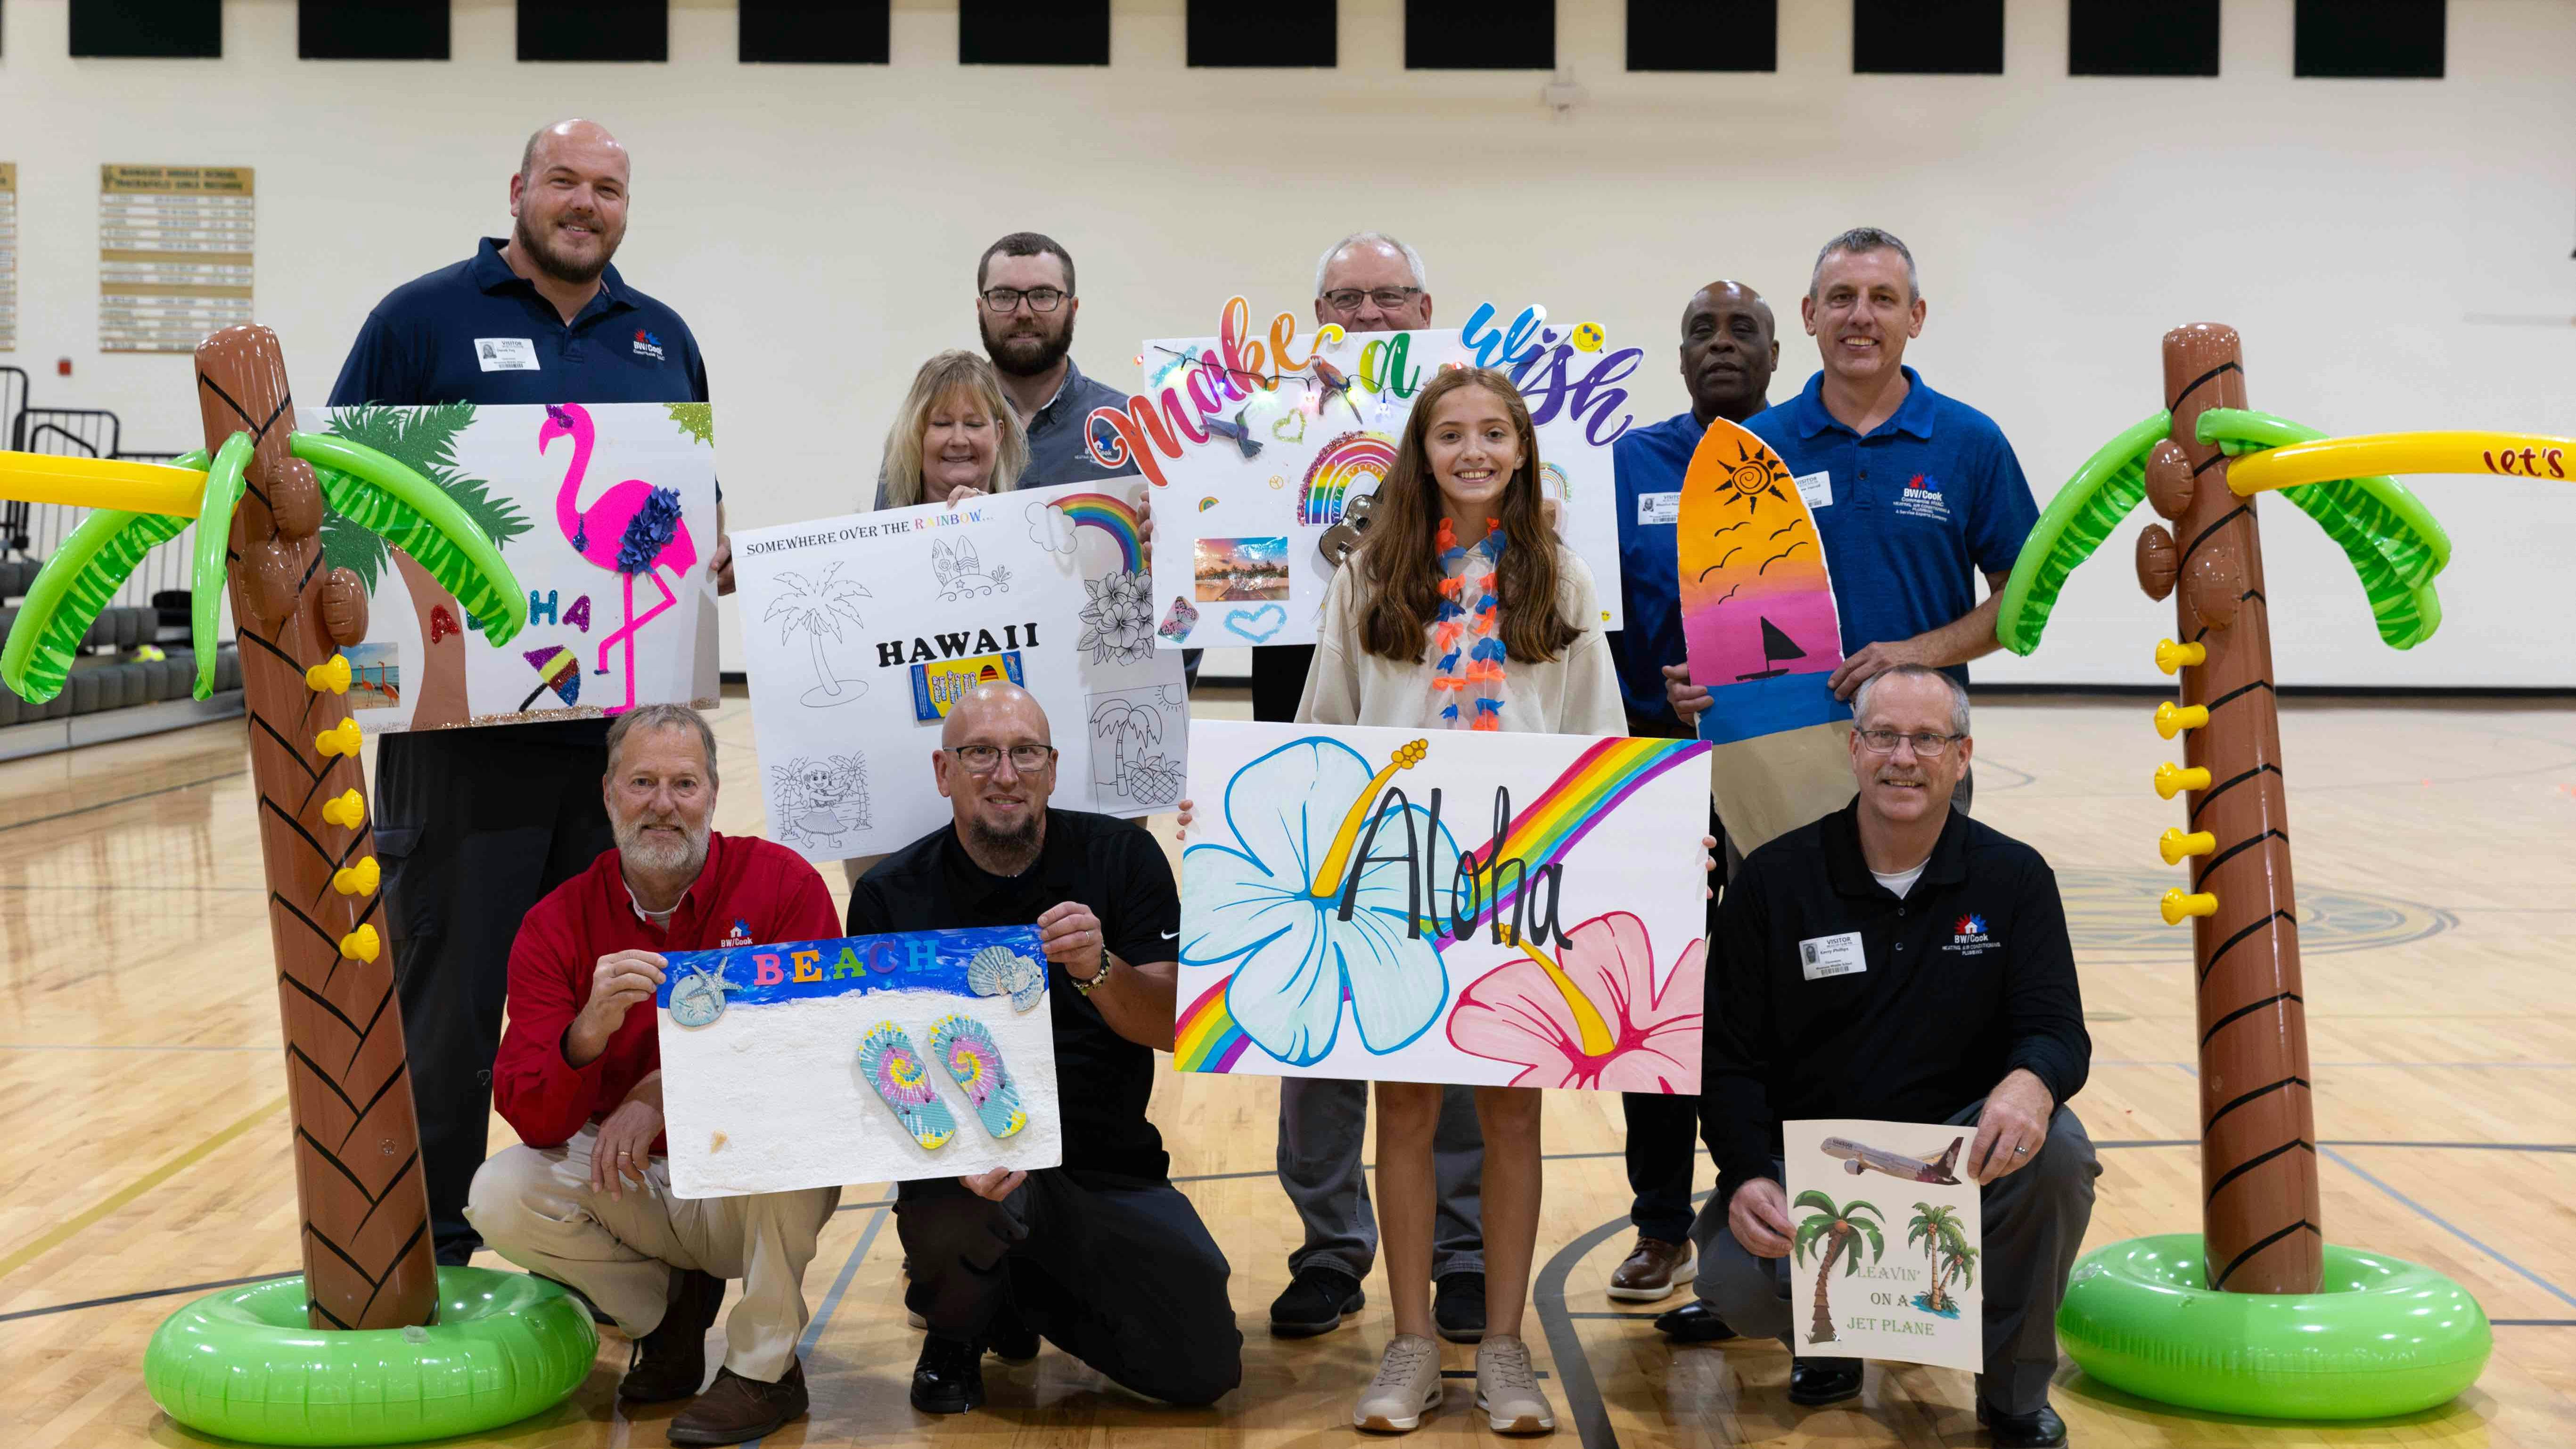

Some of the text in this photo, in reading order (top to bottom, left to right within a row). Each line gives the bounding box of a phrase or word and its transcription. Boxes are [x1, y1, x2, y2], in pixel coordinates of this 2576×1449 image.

[1085, 295, 1644, 488] Make a Wish
[1904, 488, 1942, 501] BW/Cook
[747, 531, 837, 555] SOMEWHERE
[840, 525, 878, 541] OVER
[882, 521, 910, 535] THE
[876, 622, 1040, 668] HAWAII
[1337, 785, 1573, 950] Aloha
[721, 937, 753, 948] BW/Cook
[1827, 936, 1851, 945] VISITOR
[1954, 933, 1989, 944] BW/Cook
[752, 939, 940, 986] BEACH
[1857, 1266, 1920, 1282] LEAVIN'
[1870, 1292, 1910, 1307] ON A
[1847, 1317, 1935, 1336] JET PLANE
